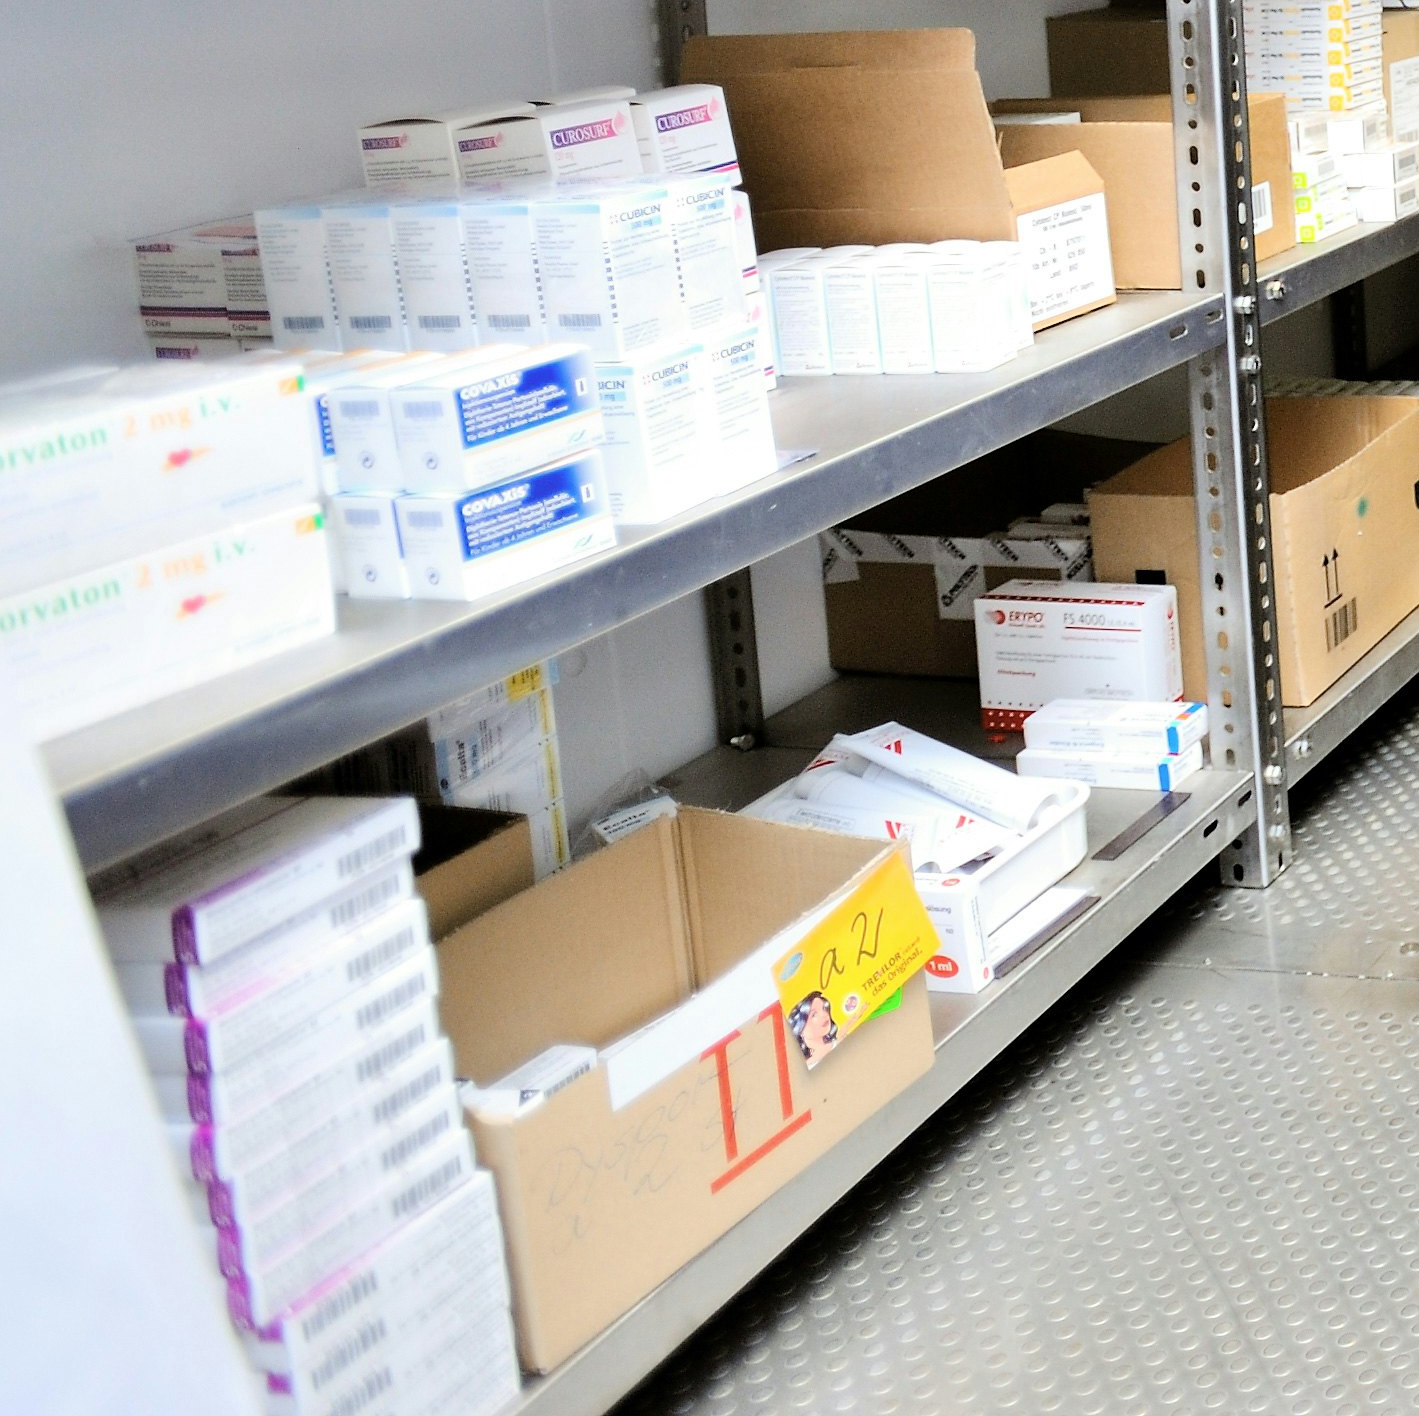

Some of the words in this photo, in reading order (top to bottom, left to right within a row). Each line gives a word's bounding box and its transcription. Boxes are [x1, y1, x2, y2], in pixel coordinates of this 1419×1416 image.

[657, 106, 708, 133] CUROSURF
[552, 119, 613, 148] CUROSURF
[686, 187, 725, 206] CUBICIN
[619, 203, 661, 223] CUBICIN
[720, 339, 755, 359] CUBICIN
[651, 361, 689, 382] CUBICIN
[460, 371, 520, 400] COVAXIS
[123, 413, 138, 439] 2
[150, 407, 192, 431] mg
[199, 395, 241, 418] i.v.
[462, 484, 529, 516] COVAXIS
[136, 563, 153, 590] 2
[162, 552, 206, 579] mg
[213, 540, 255, 565] i.v.
[1008, 610, 1044, 624] ERYPO
[1063, 613, 1076, 626] FS
[1077, 613, 1106, 626] 4000
[861, 952, 902, 992] TREVILOR
[871, 981, 888, 997] das
[887, 949, 924, 981] Original.
[937, 961, 953, 971] ml
